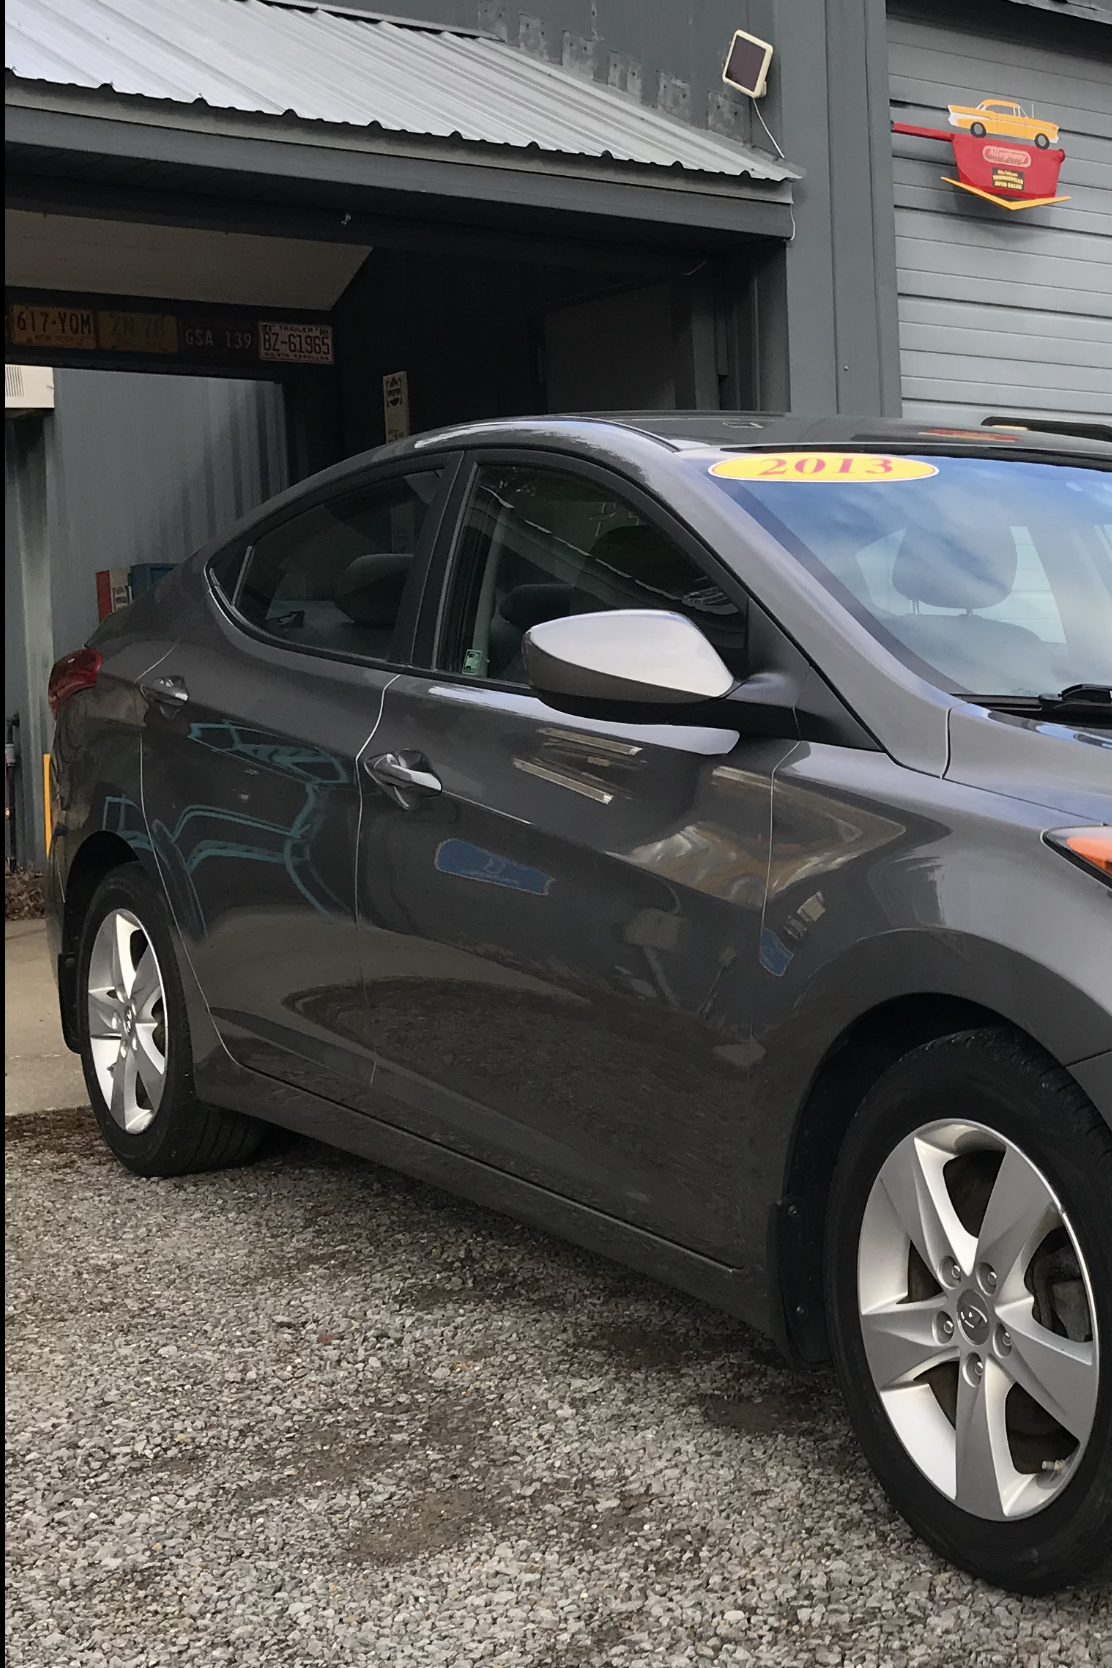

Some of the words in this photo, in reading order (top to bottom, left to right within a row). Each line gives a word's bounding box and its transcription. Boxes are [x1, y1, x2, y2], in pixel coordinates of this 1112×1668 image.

[186, 328, 213, 346] GSA
[225, 331, 251, 349] 139
[263, 332, 329, 355] BZ-61965
[757, 457, 894, 475] 2013
